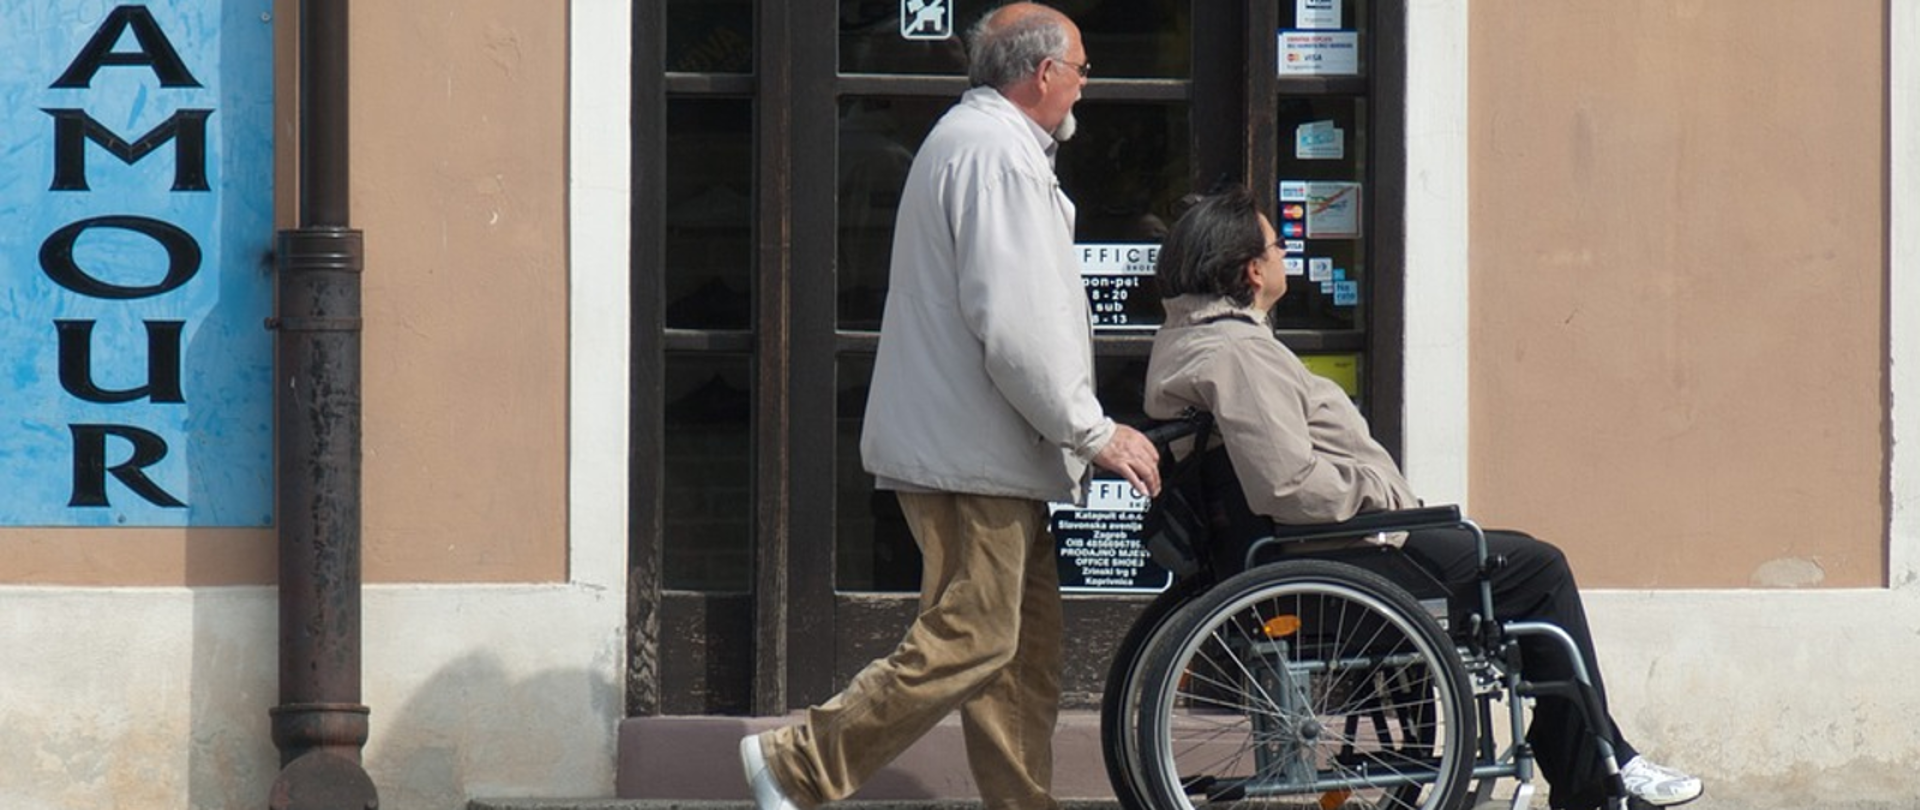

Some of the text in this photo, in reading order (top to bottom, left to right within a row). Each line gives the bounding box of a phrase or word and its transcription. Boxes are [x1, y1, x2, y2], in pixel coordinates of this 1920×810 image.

[1304, 53, 1323, 61] VISA
[1083, 248, 1156, 263] FFICE
[1092, 290, 1099, 300] 8
[1112, 290, 1127, 300] 20
[1096, 302, 1123, 312] sub
[1112, 315, 1127, 323] 13
[1058, 521, 1143, 532] Slavonska avenija
[1093, 531, 1127, 541] Zagreb
[1066, 539, 1084, 547] OIB
[1061, 549, 1116, 557] PRODAJNO
[1075, 558, 1109, 566] OFFICE
[1082, 567, 1113, 575] Zrinski
[1116, 567, 1130, 577] trg
[1085, 576, 1134, 586] Koprivnica
